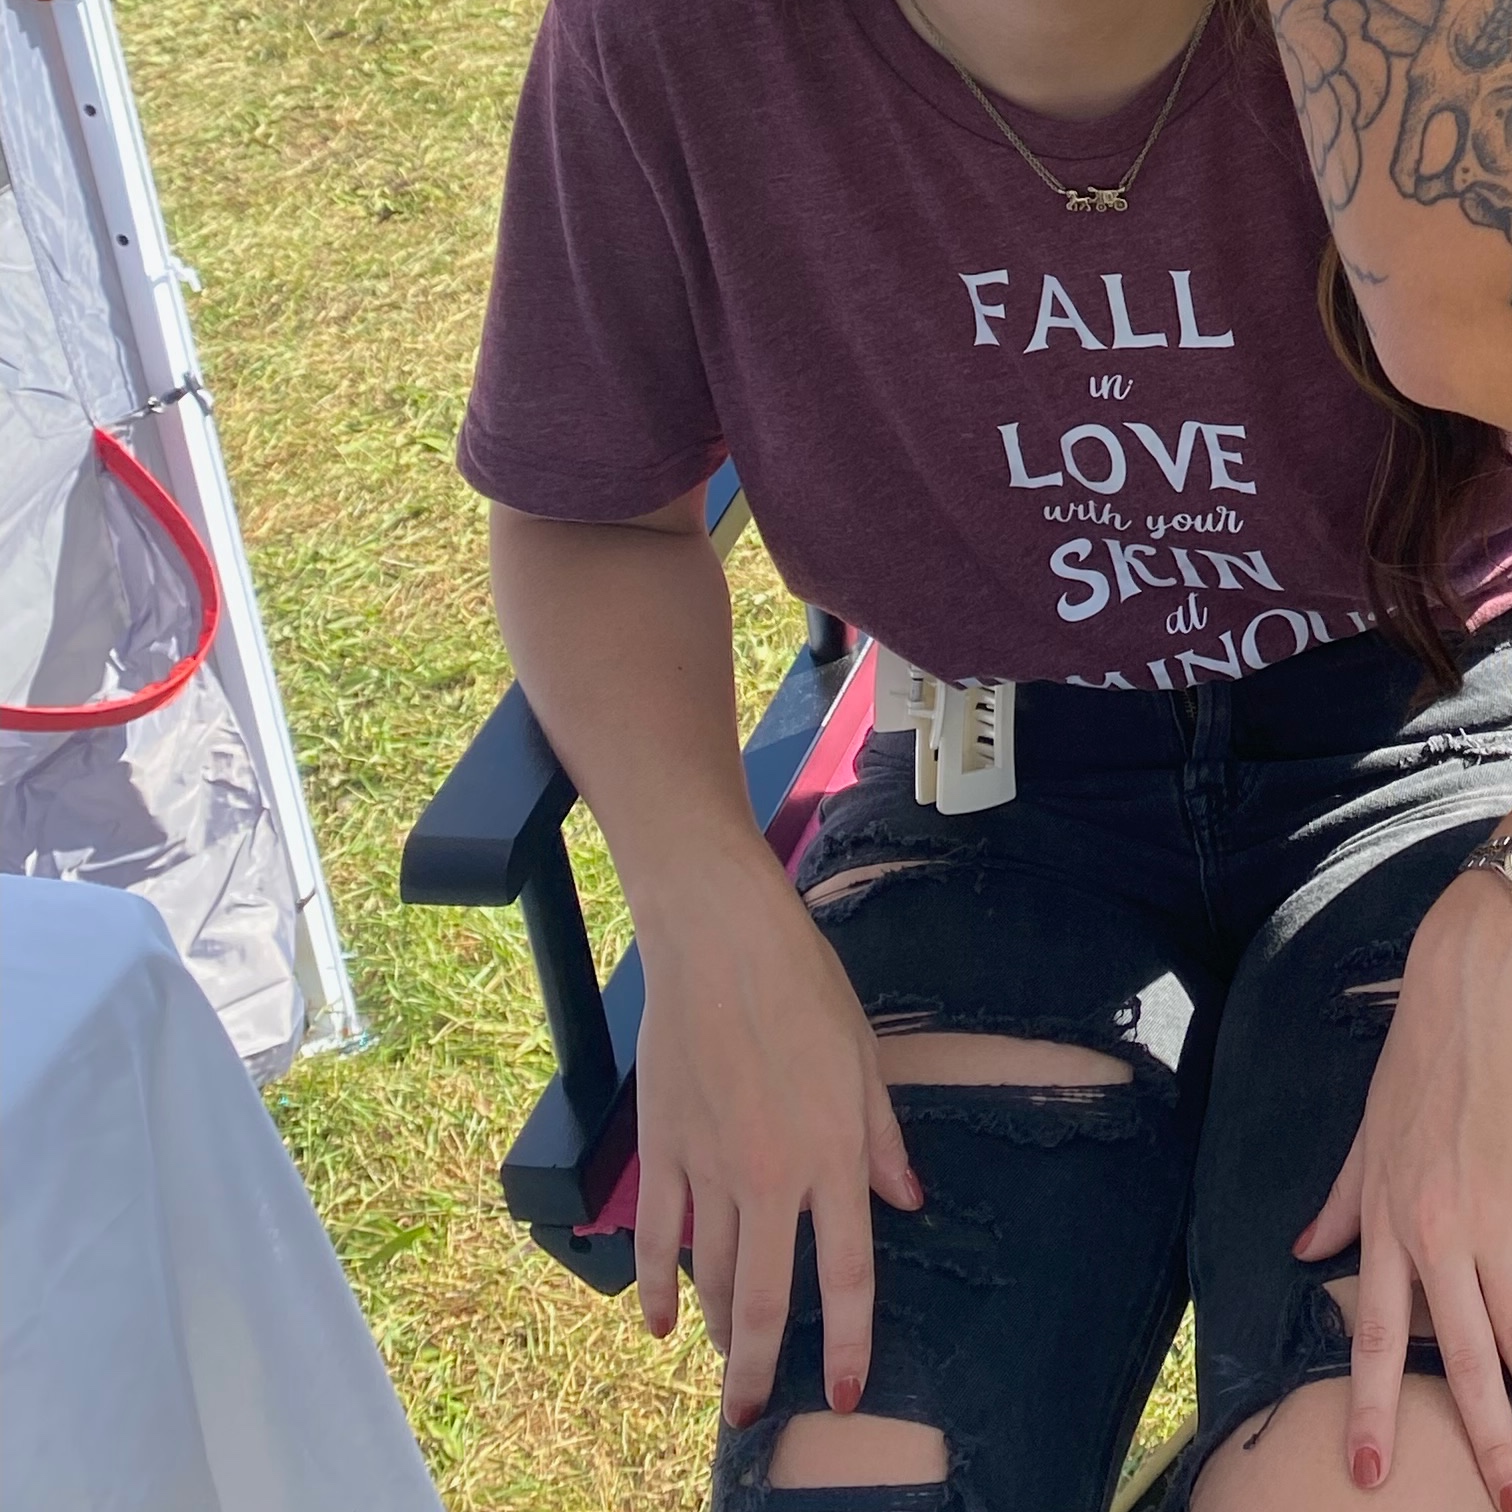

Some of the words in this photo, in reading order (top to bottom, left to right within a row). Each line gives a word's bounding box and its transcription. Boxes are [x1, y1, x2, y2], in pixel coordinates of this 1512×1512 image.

[958, 269, 1235, 355] FALL
[1089, 372, 1134, 400] in
[997, 420, 1257, 495] LOVE
[1044, 500, 1132, 530] with
[1146, 504, 1244, 539] your
[1049, 538, 1285, 622] SKIN
[1166, 592, 1208, 635] at
